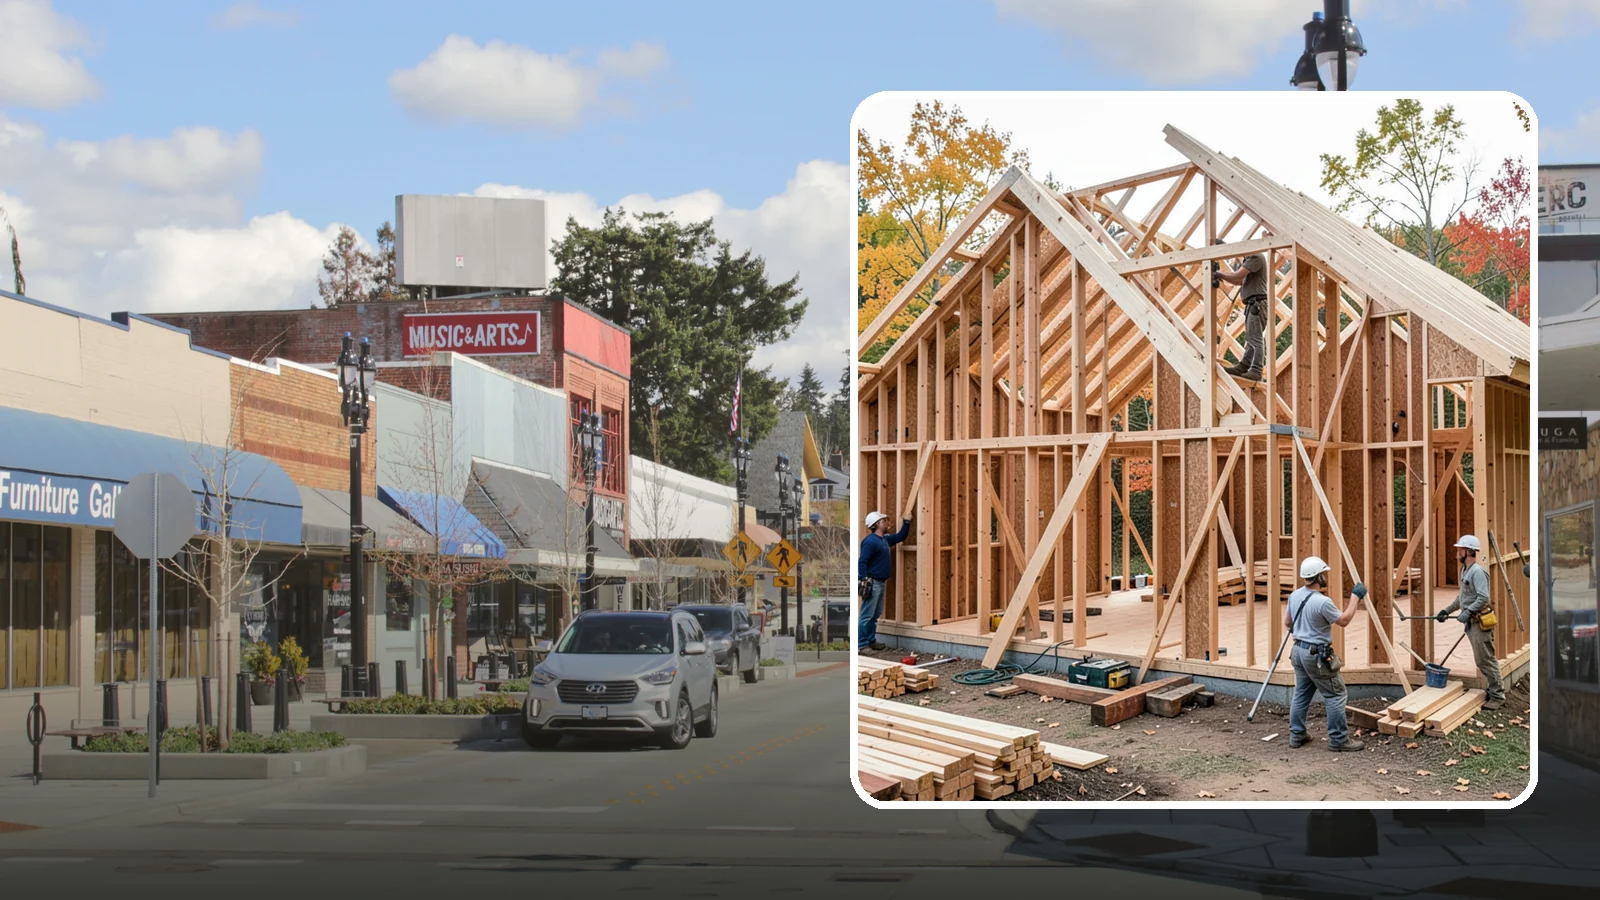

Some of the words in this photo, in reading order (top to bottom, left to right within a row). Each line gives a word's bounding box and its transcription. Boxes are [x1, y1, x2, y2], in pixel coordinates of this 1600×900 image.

[409, 323, 519, 348] MUSIC&ARTS
[1540, 427, 1577, 437] UGA
[0, 471, 79, 515] Furniture
[89, 482, 122, 519] Gal
